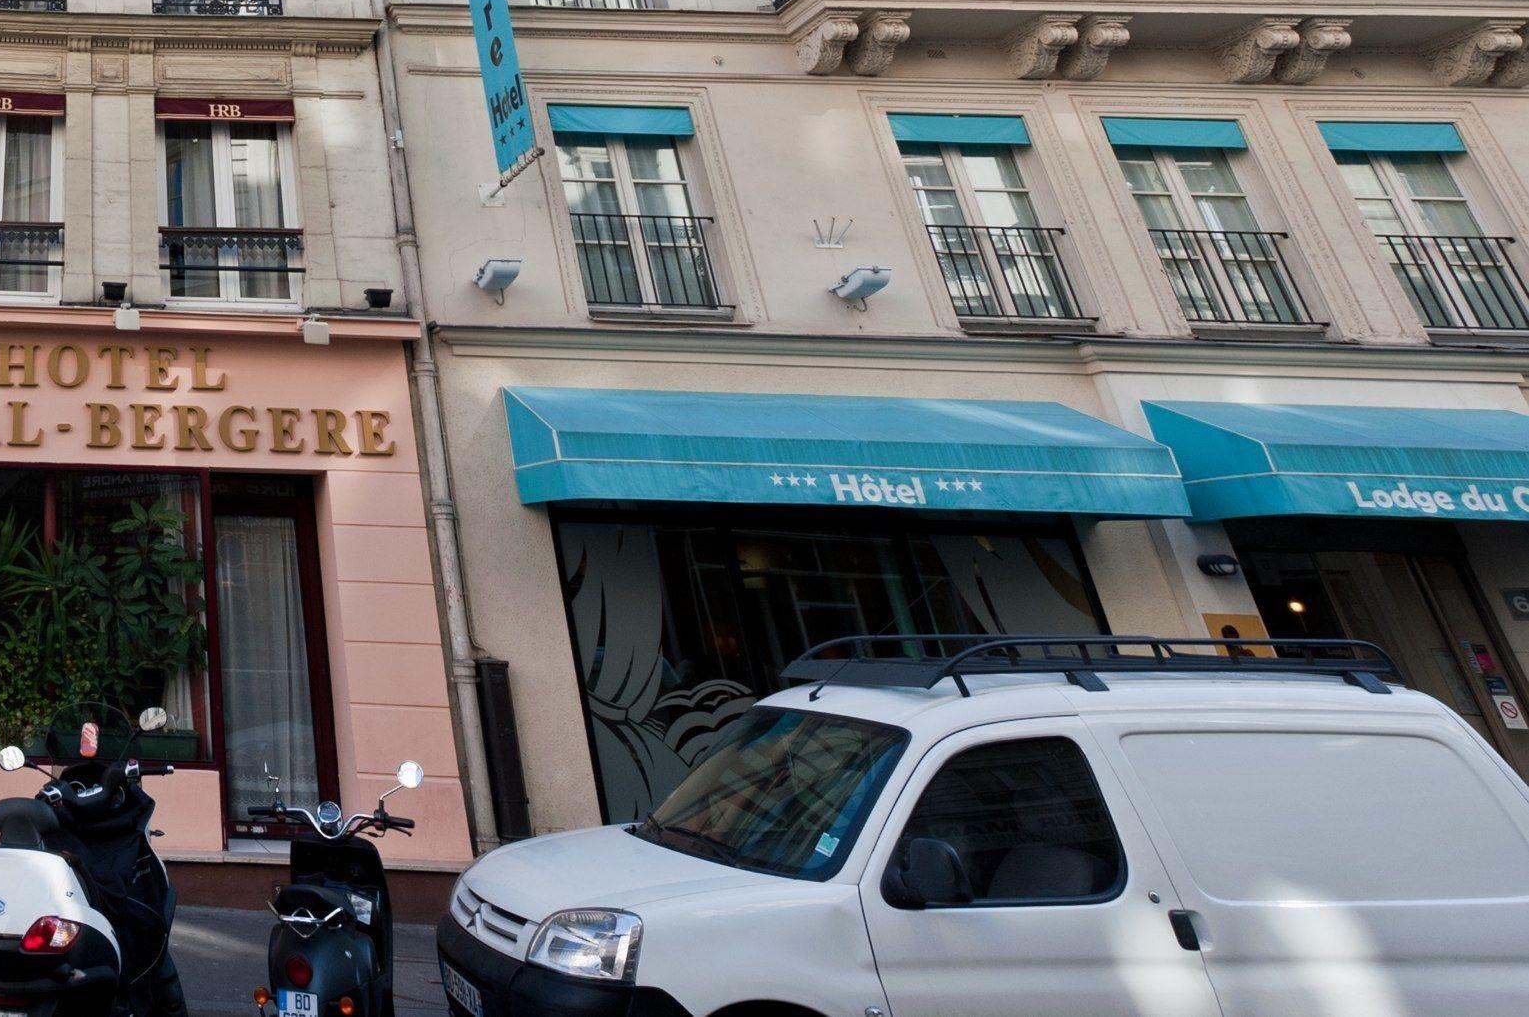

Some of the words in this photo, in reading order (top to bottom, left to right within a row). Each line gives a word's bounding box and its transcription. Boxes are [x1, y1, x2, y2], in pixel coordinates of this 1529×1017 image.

[208, 104, 241, 118] HRB
[490, 74, 524, 128] Hotel
[830, 473, 927, 505] Hôtel
[1346, 481, 1456, 514] Lodge
[1461, 484, 1509, 512] du
[295, 993, 311, 1011] BD
